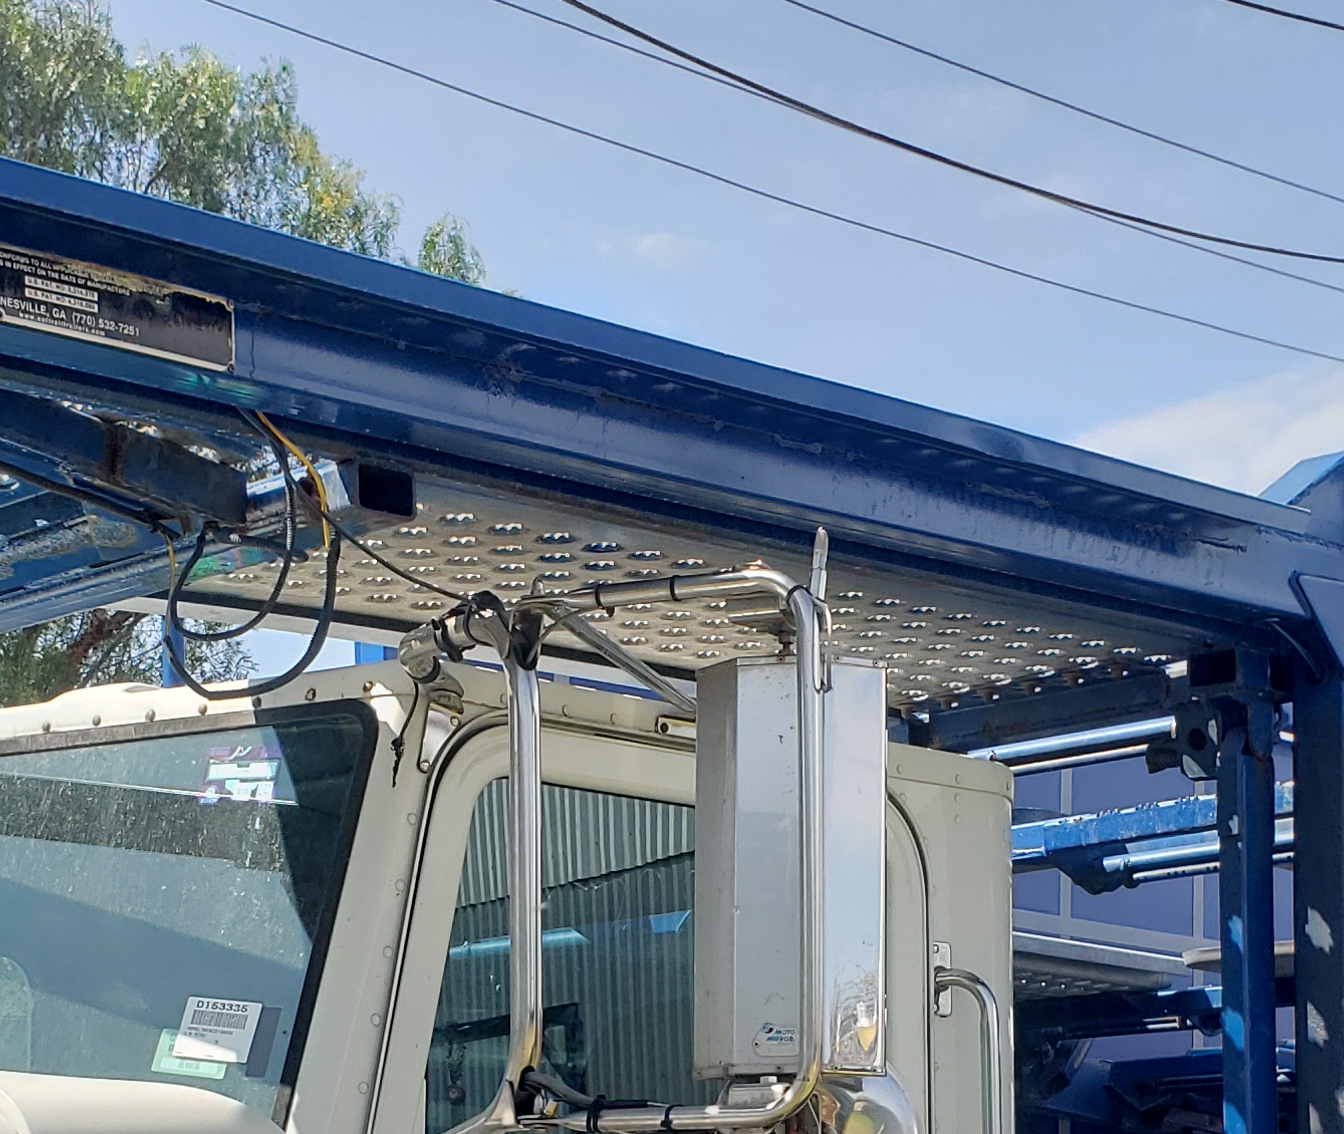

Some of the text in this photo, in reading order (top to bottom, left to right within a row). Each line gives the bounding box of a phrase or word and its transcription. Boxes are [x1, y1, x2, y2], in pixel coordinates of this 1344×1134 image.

[5, 260, 12, 268] IN
[13, 262, 36, 274] EFFECT
[37, 267, 46, 276] ON
[47, 270, 60, 280] THE
[60, 273, 76, 283] DATE
[77, 276, 86, 285] OF
[31, 258, 39, 266] TO
[40, 260, 52, 269] ALL
[52, 307, 66, 320] GA
[72, 312, 96, 328] (770)
[98, 317, 140, 337] 532-7251
